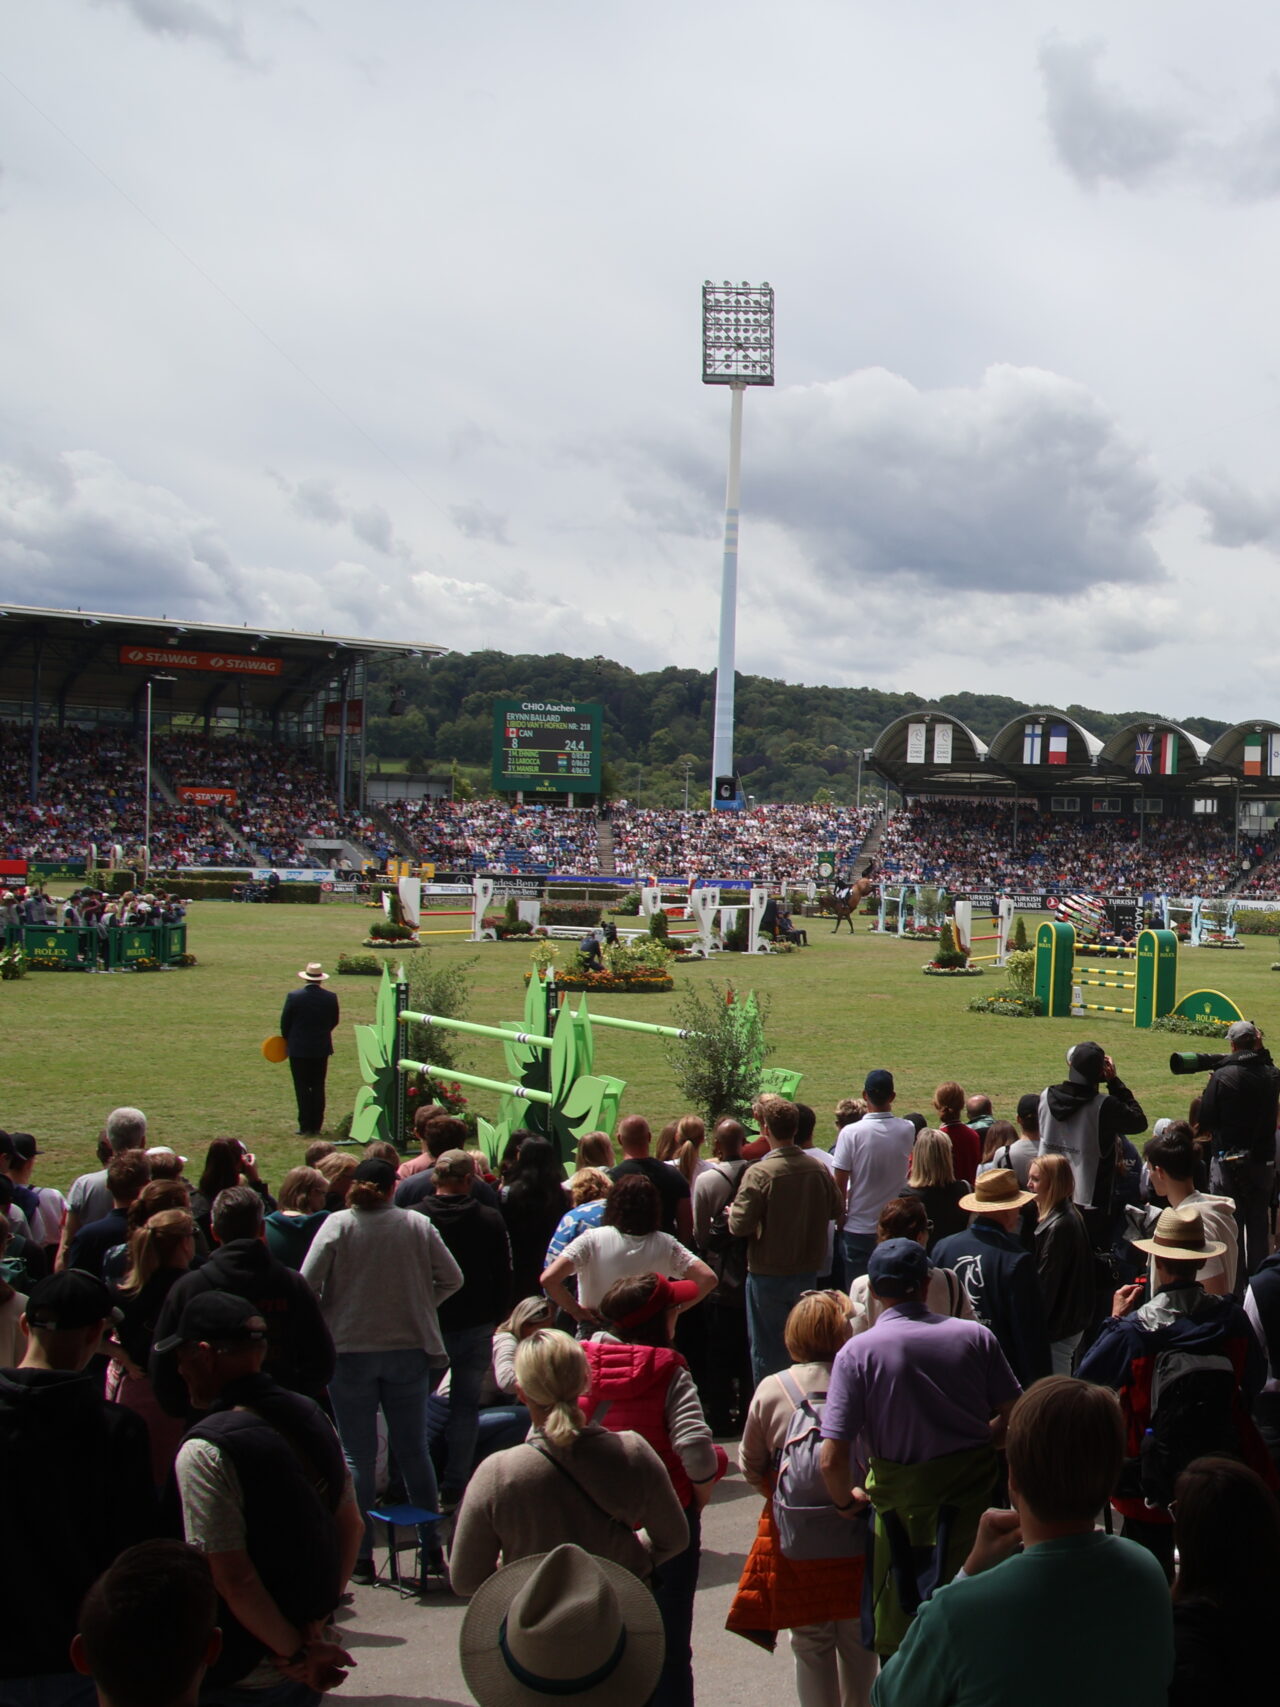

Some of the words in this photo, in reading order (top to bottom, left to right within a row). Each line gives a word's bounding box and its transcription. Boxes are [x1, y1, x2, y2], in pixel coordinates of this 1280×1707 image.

[145, 652, 197, 665] STAWAG
[226, 659, 276, 672] STAWAG
[521, 702, 545, 711] CHIO
[545, 704, 576, 713] Aachen
[506, 713, 530, 721] ERYNN
[530, 714, 561, 722] BALLARD
[519, 729, 533, 737] CAN
[511, 738, 518, 749] 8
[564, 740, 585, 751] 24.4
[492, 879, 540, 888] edes-Benz
[34, 948, 68, 956] ROLEX
[1196, 1014, 1218, 1022] ROLEX
